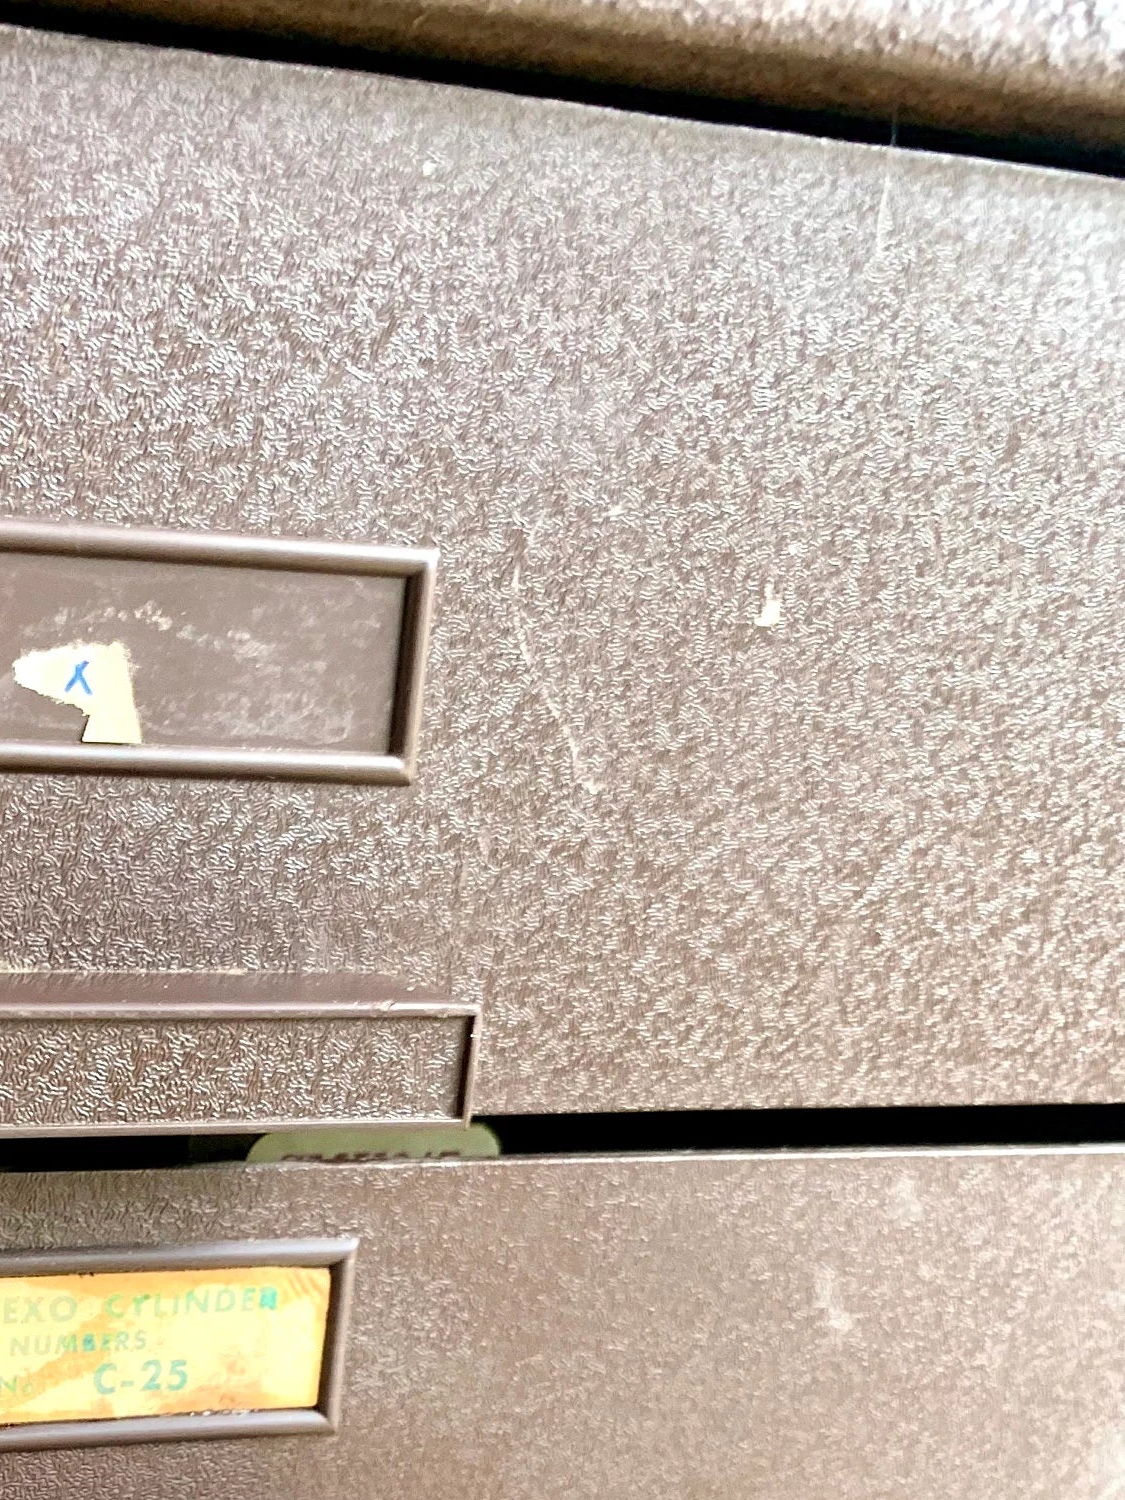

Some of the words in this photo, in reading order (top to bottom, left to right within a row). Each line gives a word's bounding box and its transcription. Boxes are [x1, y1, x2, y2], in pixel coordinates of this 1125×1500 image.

[104, 1284, 279, 1320] CYLINDER
[9, 1328, 147, 1358] NUMBERS
[93, 1358, 190, 1396] C-25
